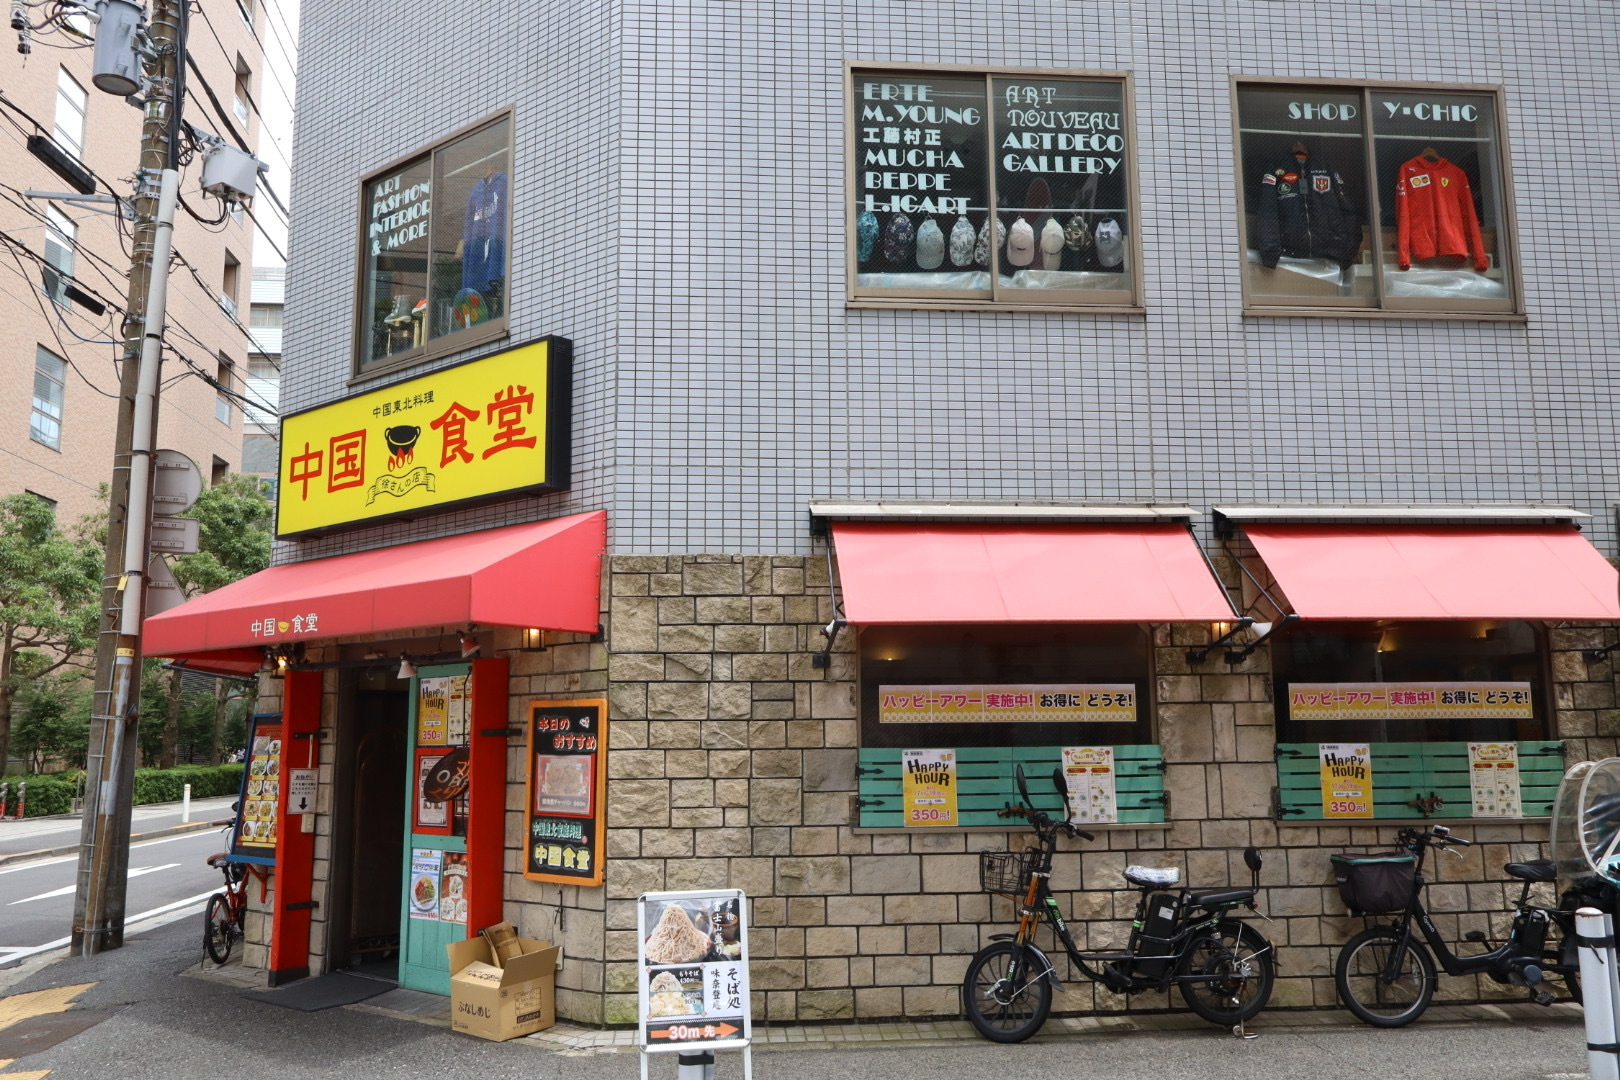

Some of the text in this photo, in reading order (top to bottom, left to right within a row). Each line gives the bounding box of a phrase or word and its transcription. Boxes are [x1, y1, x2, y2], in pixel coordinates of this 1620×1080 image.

[863, 82, 934, 102] ERTE
[1005, 85, 1056, 108] ART
[1288, 101, 1357, 121] SHOP
[1006, 109, 1119, 134] NOUVEAU
[863, 127, 942, 146] 工藤村正
[864, 149, 965, 169] MUCHA
[1003, 154, 1122, 175] GALLERY
[374, 174, 403, 199] ART
[865, 171, 952, 191] BEPPE
[372, 179, 431, 218] FASHION
[369, 199, 431, 239] INTERIOR
[371, 220, 428, 257] & MORE
[373, 390, 435, 419] 中国東北料理
[289, 385, 537, 502] 中国 食堂
[251, 612, 318, 638] 中国 食堂
[422, 686, 445, 700] HAPPY
[425, 698, 445, 710] HOUR
[538, 717, 570, 732] 本日の
[553, 734, 597, 750] おすすめ
[907, 758, 949, 774] HAPPY
[1324, 752, 1364, 767] HAPPY
[914, 772, 950, 787] HOUR
[1331, 765, 1366, 780] HOUR
[534, 844, 590, 870] 中国食堂
[727, 967, 741, 1010] そば処
[458, 1001, 491, 1019] ぶなしめじ
